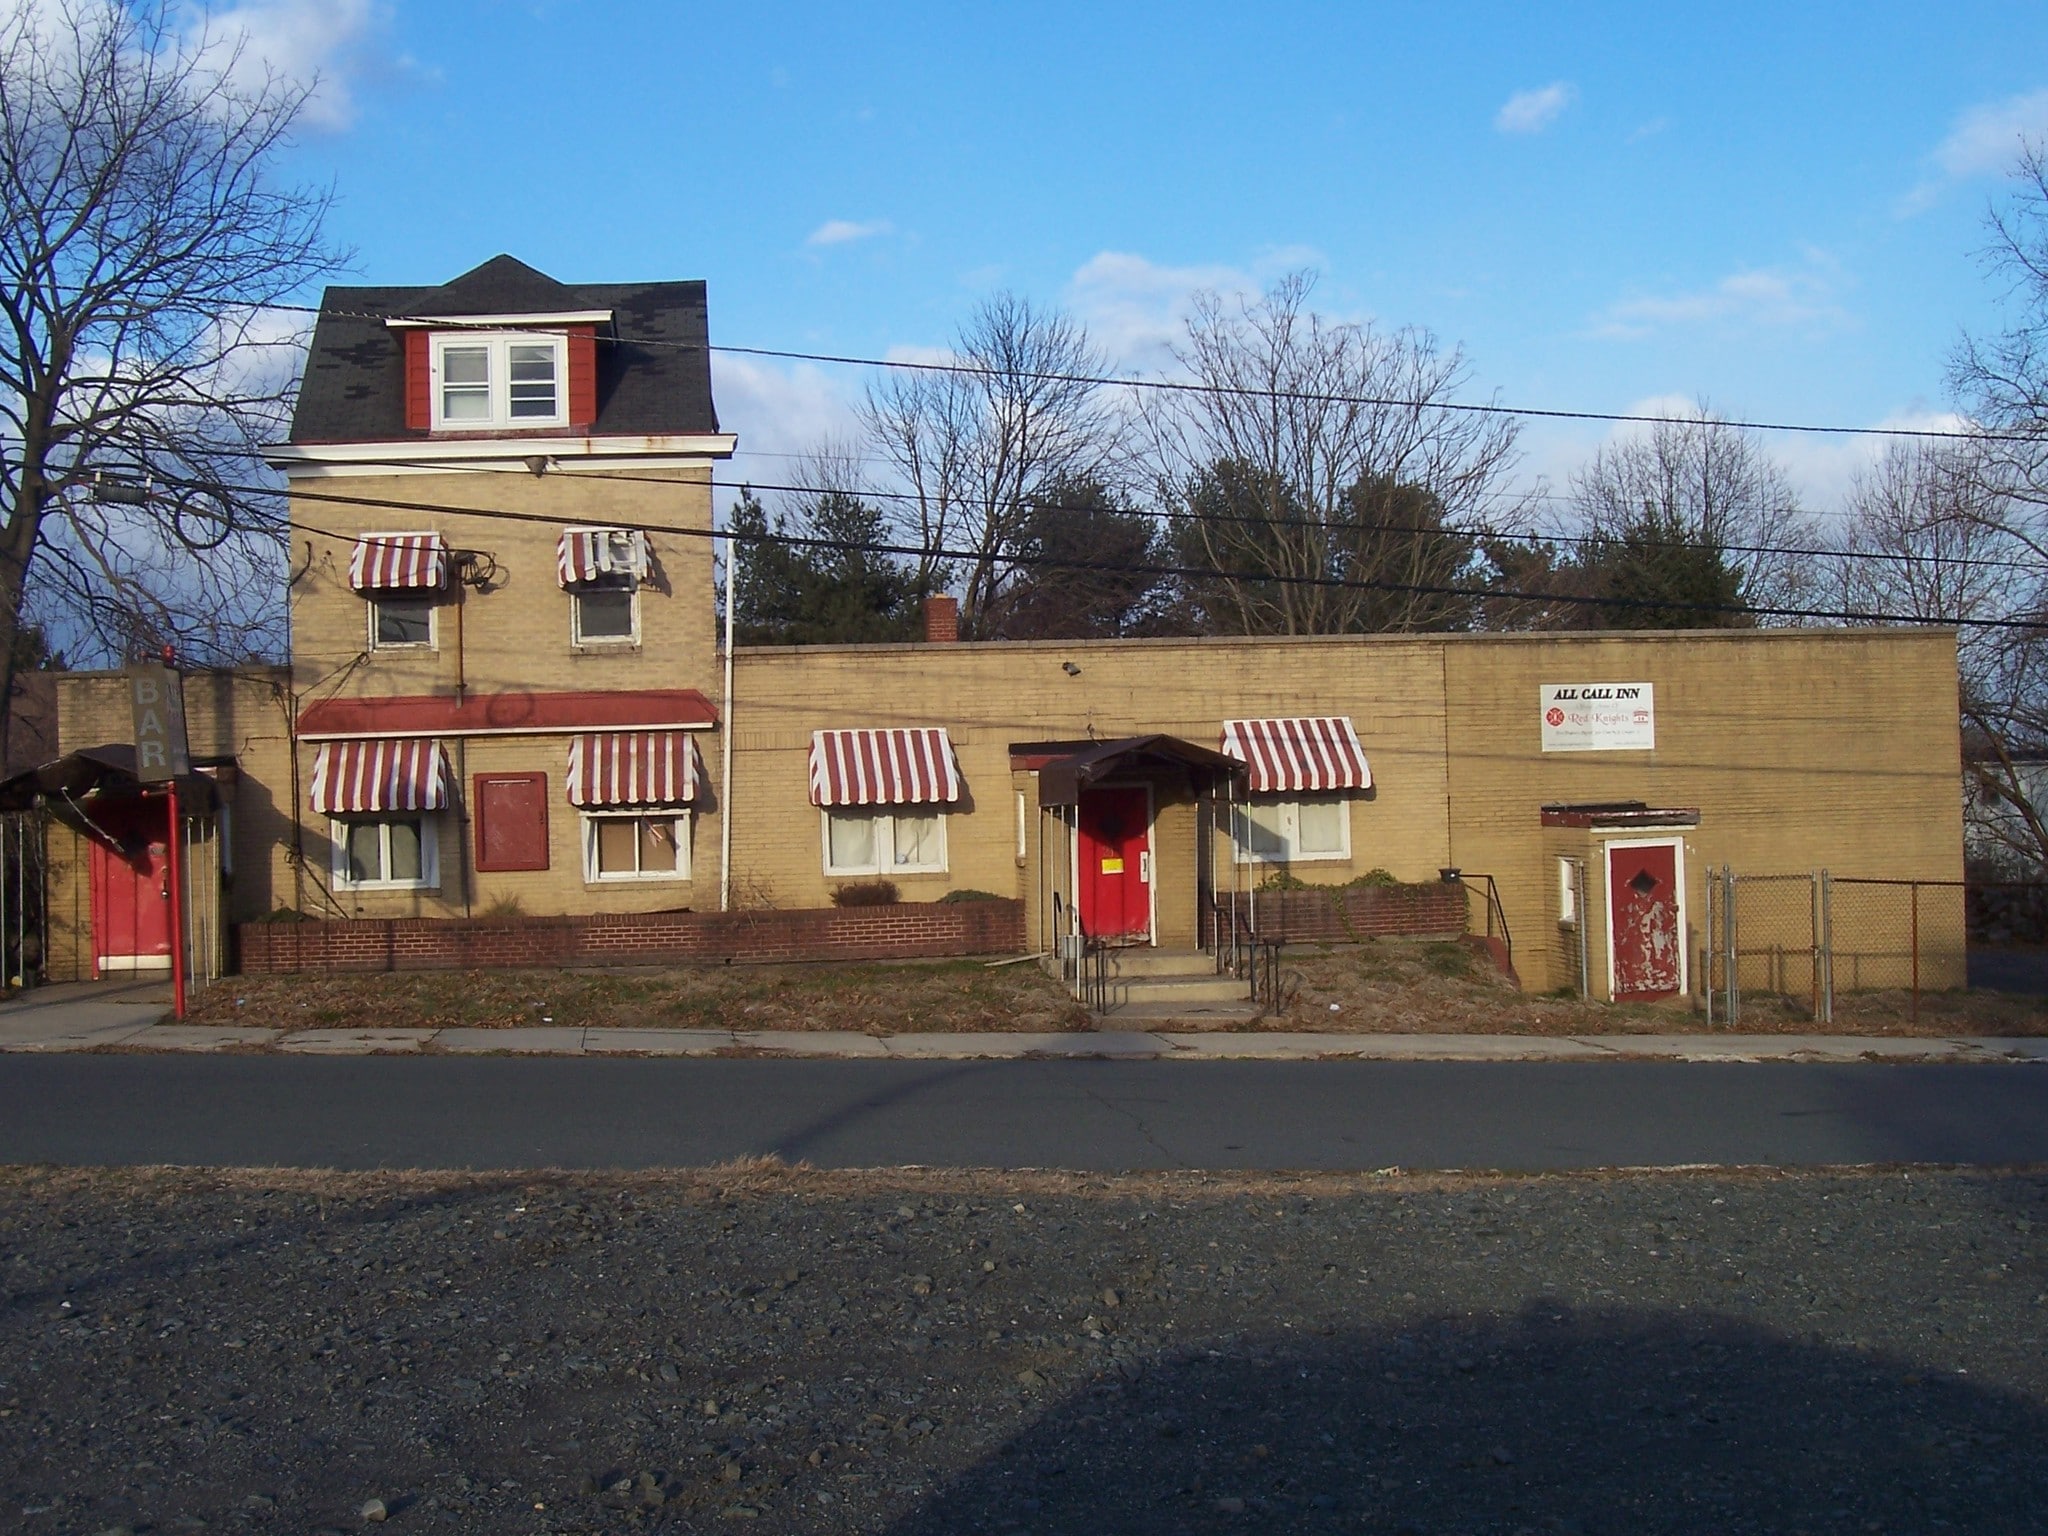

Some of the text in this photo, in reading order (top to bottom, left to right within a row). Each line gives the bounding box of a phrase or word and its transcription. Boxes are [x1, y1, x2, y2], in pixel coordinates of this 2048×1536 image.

[1553, 688, 1641, 700] ALL CALL INN
[136, 678, 166, 769] BAR
[1568, 713, 1589, 726] Red
[1592, 712, 1629, 726] Knights
